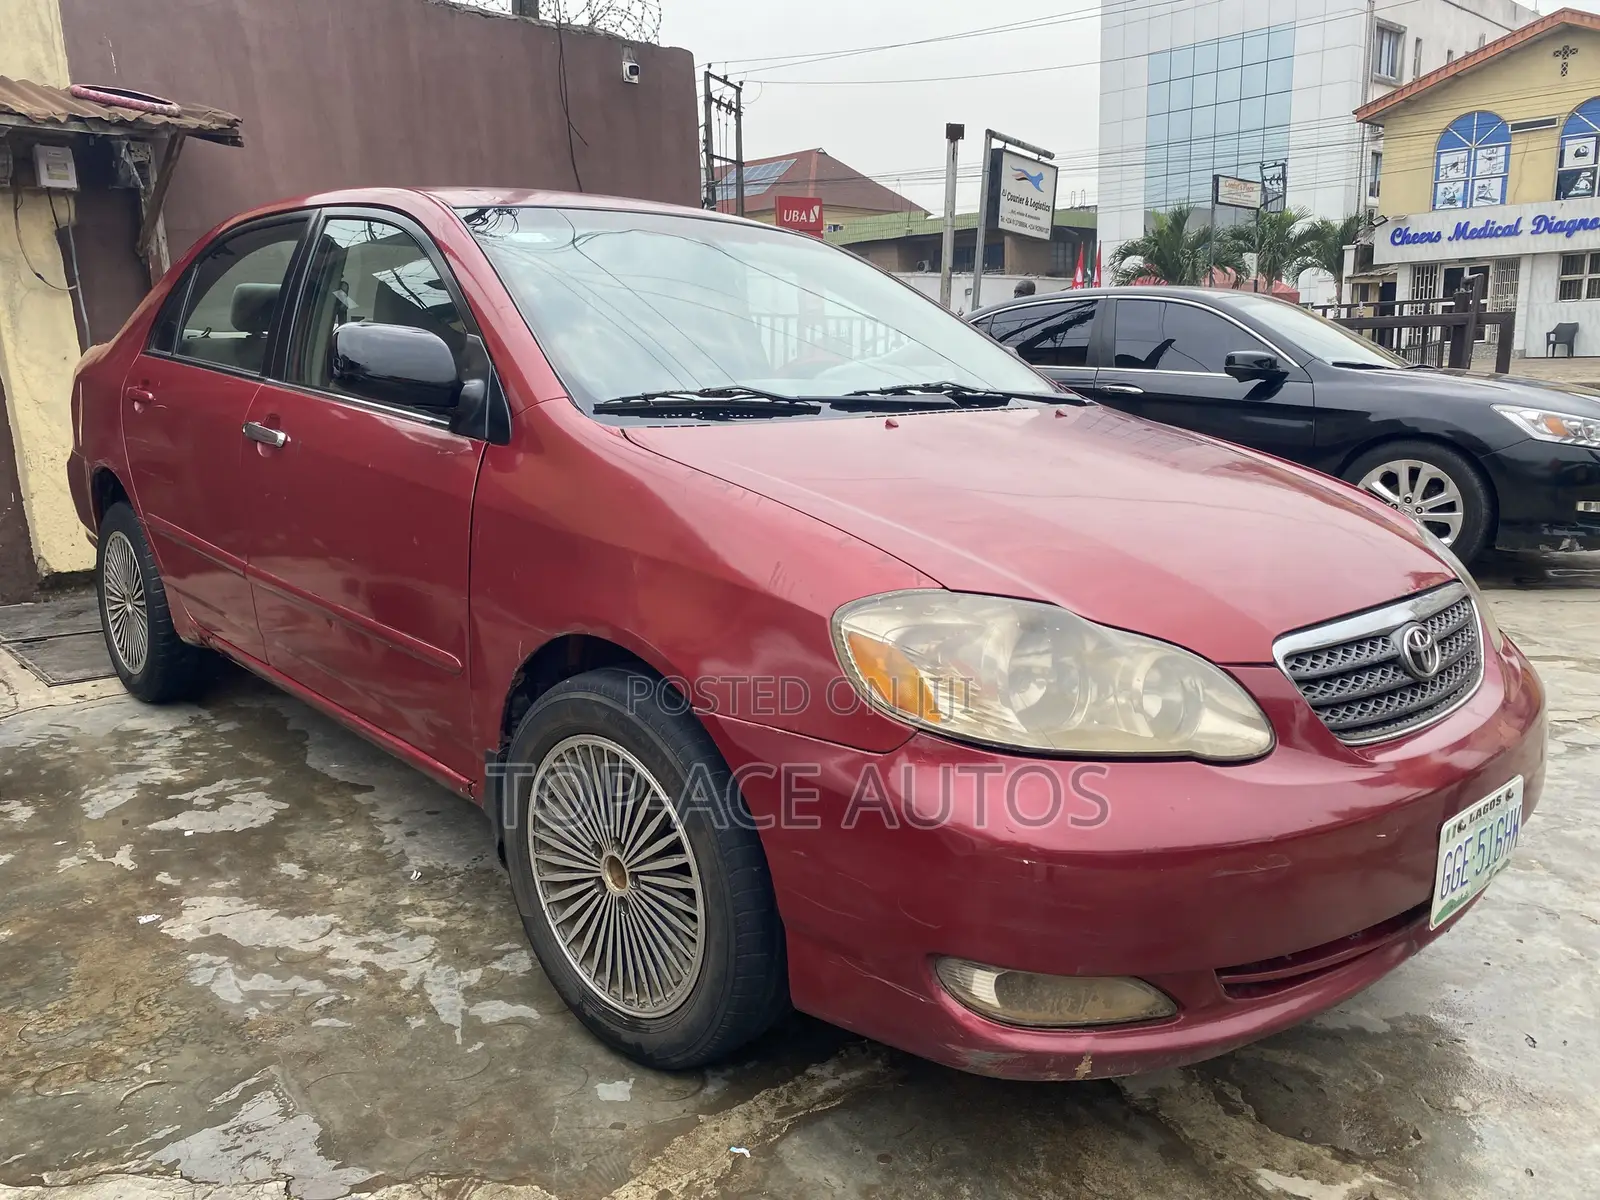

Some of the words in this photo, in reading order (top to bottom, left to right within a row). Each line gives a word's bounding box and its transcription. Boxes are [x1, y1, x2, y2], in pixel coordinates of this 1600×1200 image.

[1007, 192, 1025, 205] Courier
[1025, 197, 1029, 206] &
[1030, 198, 1051, 212] Logistics
[783, 210, 807, 222] UBA
[1390, 226, 1442, 246] Cheers
[1448, 217, 1522, 241] Medical
[1469, 795, 1502, 824] LAGOS
